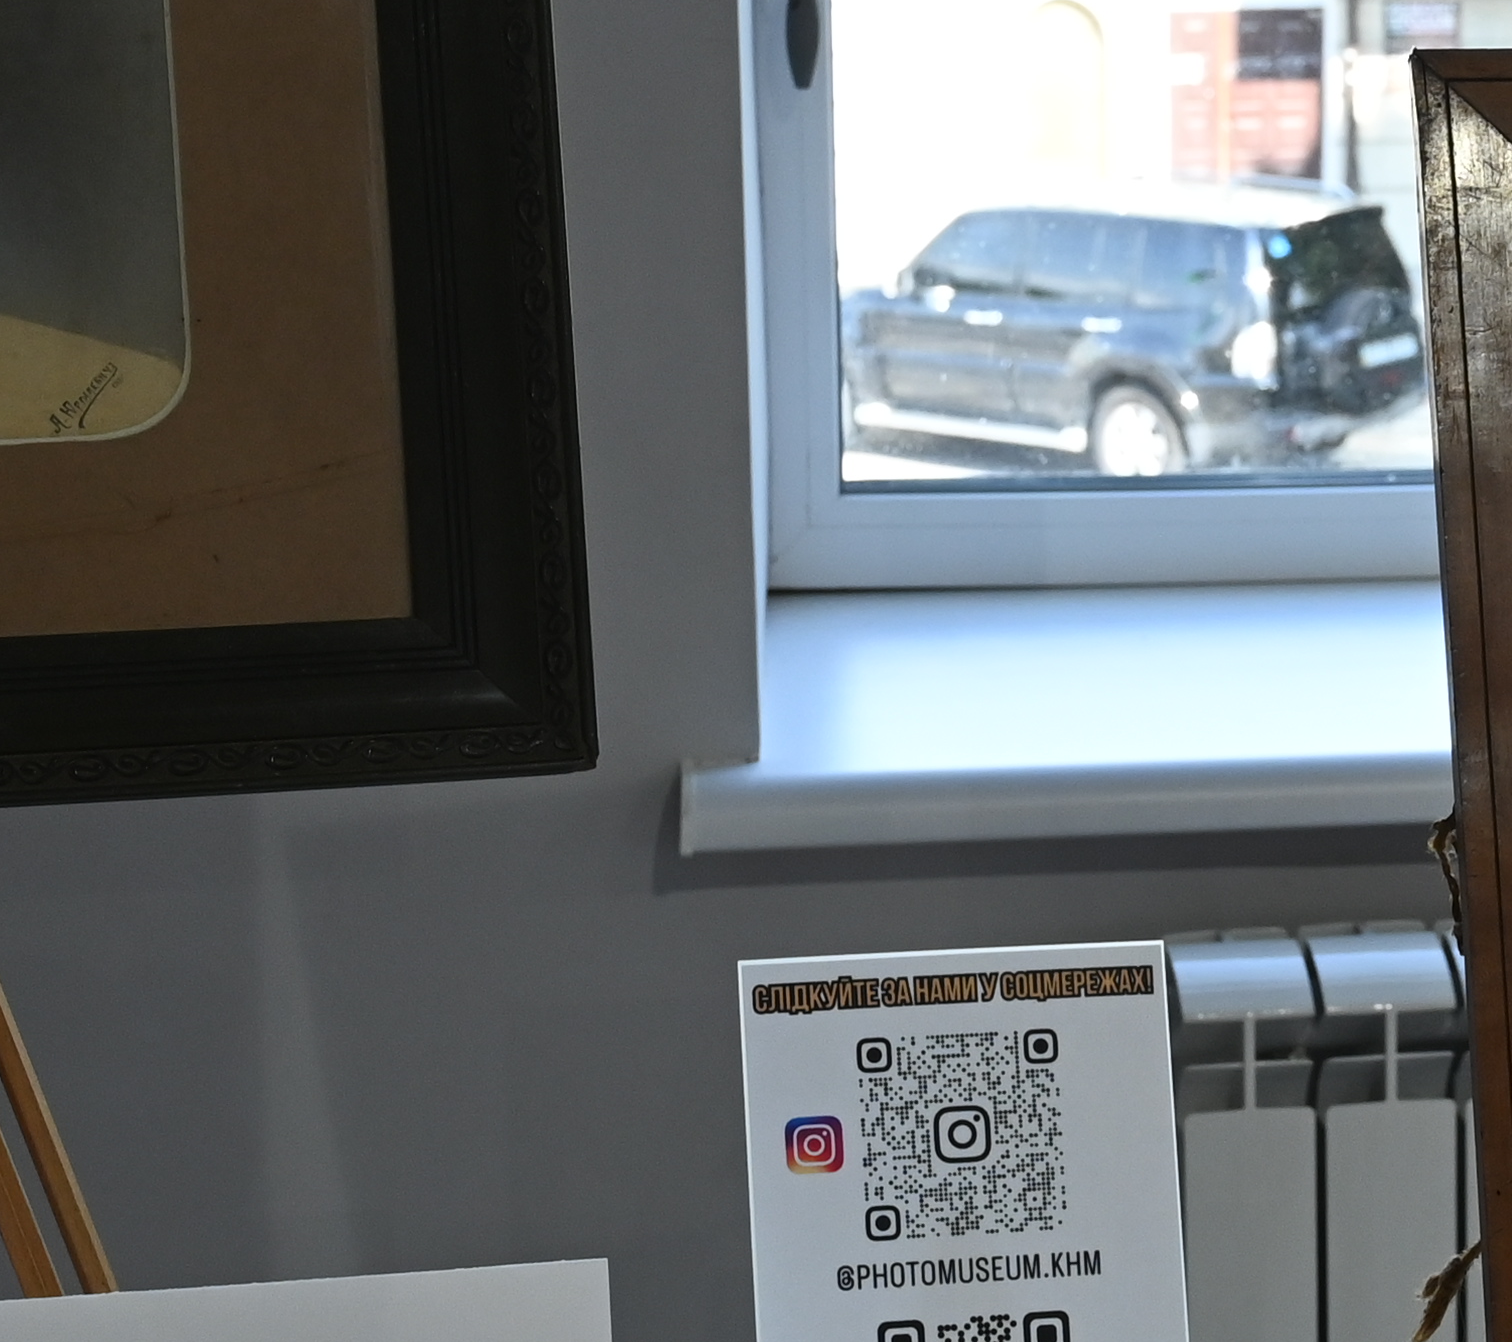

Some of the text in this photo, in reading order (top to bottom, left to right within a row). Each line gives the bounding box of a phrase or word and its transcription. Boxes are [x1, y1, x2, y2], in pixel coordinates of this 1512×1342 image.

[753, 965, 1155, 1015] СЛІДКУЙТЕ ЗА НАМИ У СОЦМЕРЕЖАХ!
[837, 1250, 1102, 1291] @PHOTOMUSEUM.KHM
